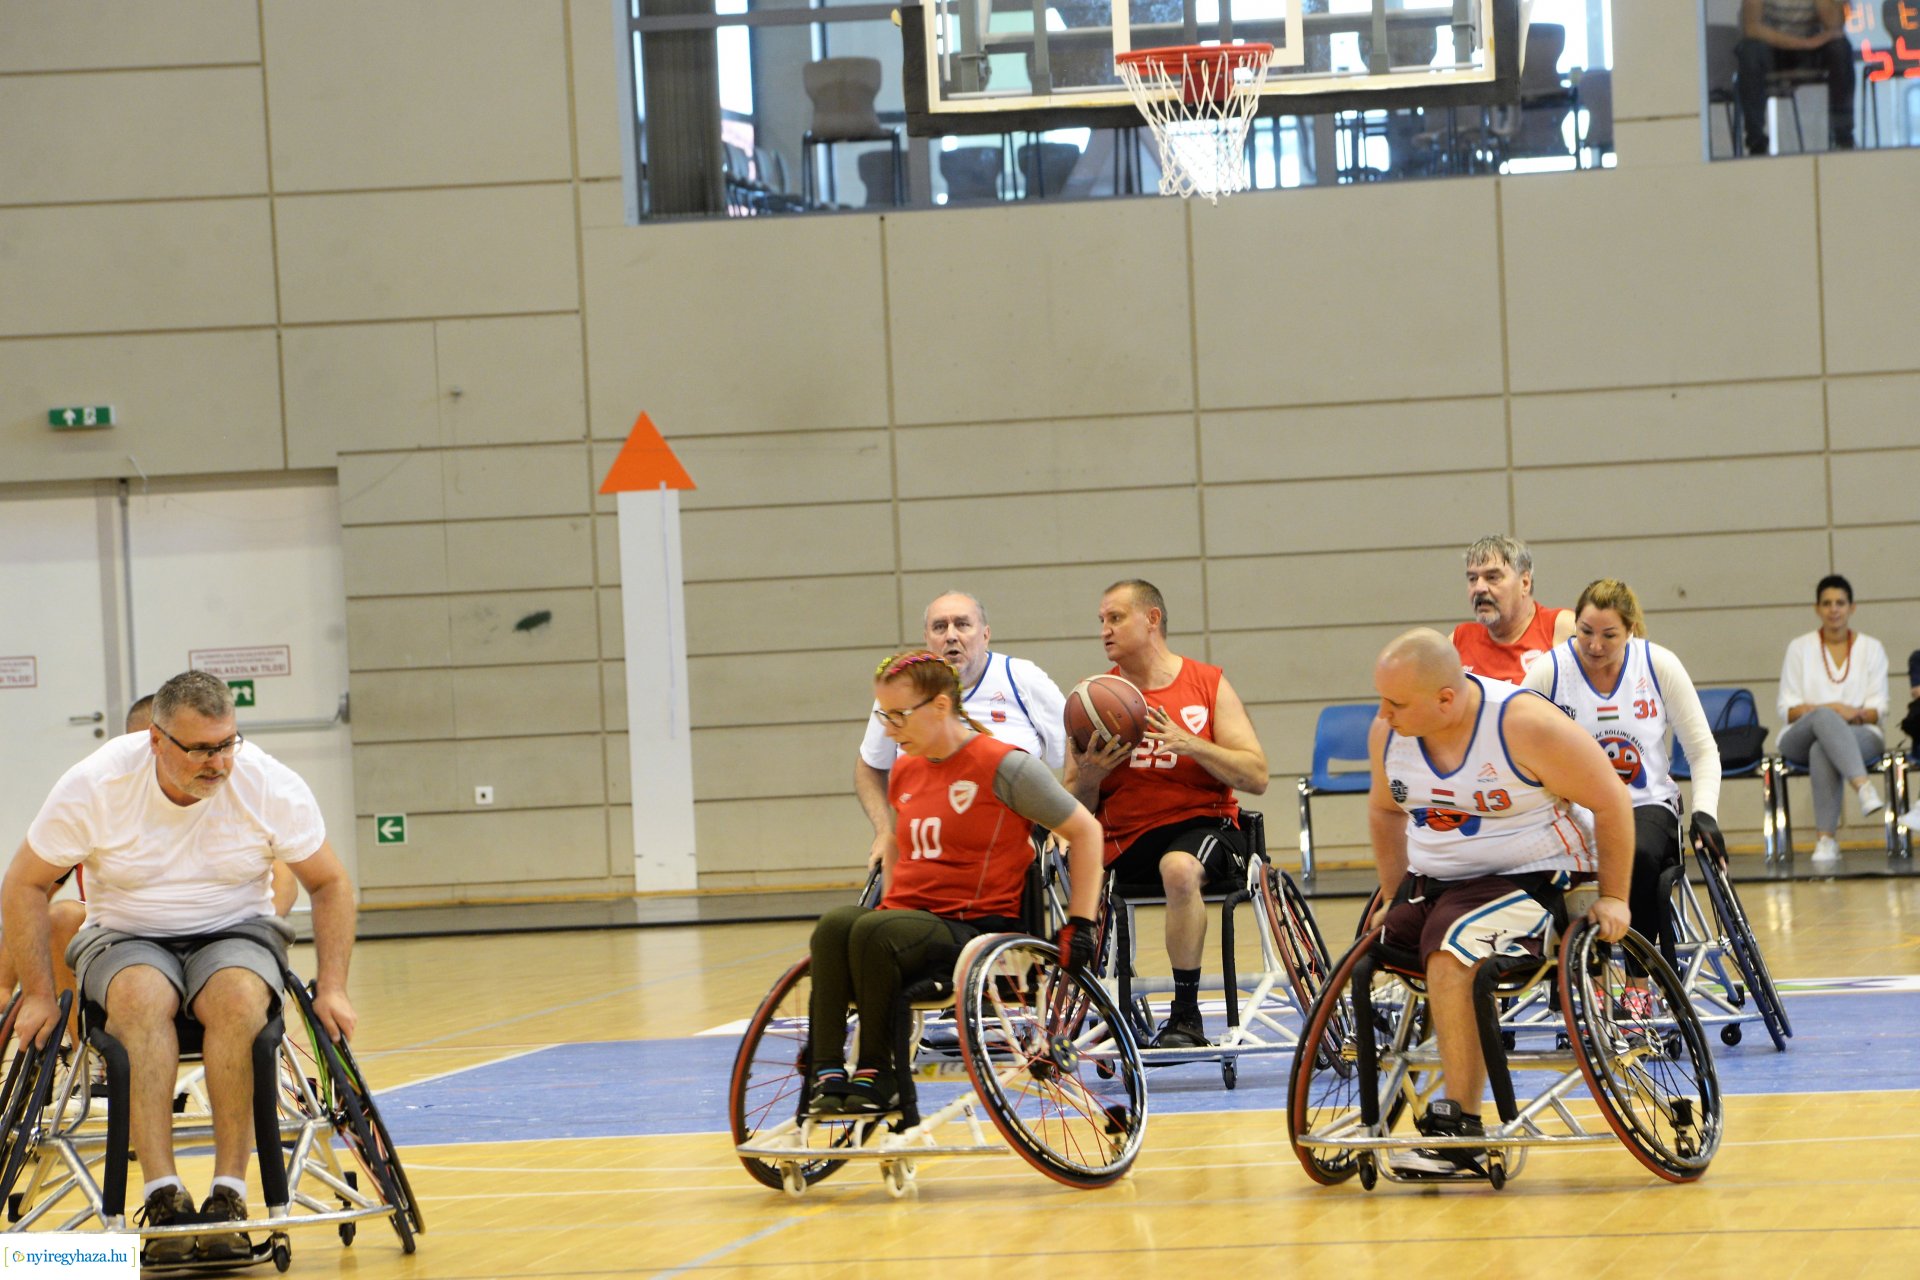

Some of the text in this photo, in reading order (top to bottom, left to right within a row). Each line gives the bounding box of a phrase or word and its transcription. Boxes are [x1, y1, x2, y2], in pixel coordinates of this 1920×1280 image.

[1633, 698, 1658, 719] 31
[1129, 736, 1178, 769] 25
[1473, 788, 1512, 812] 13
[909, 816, 943, 860] 10
